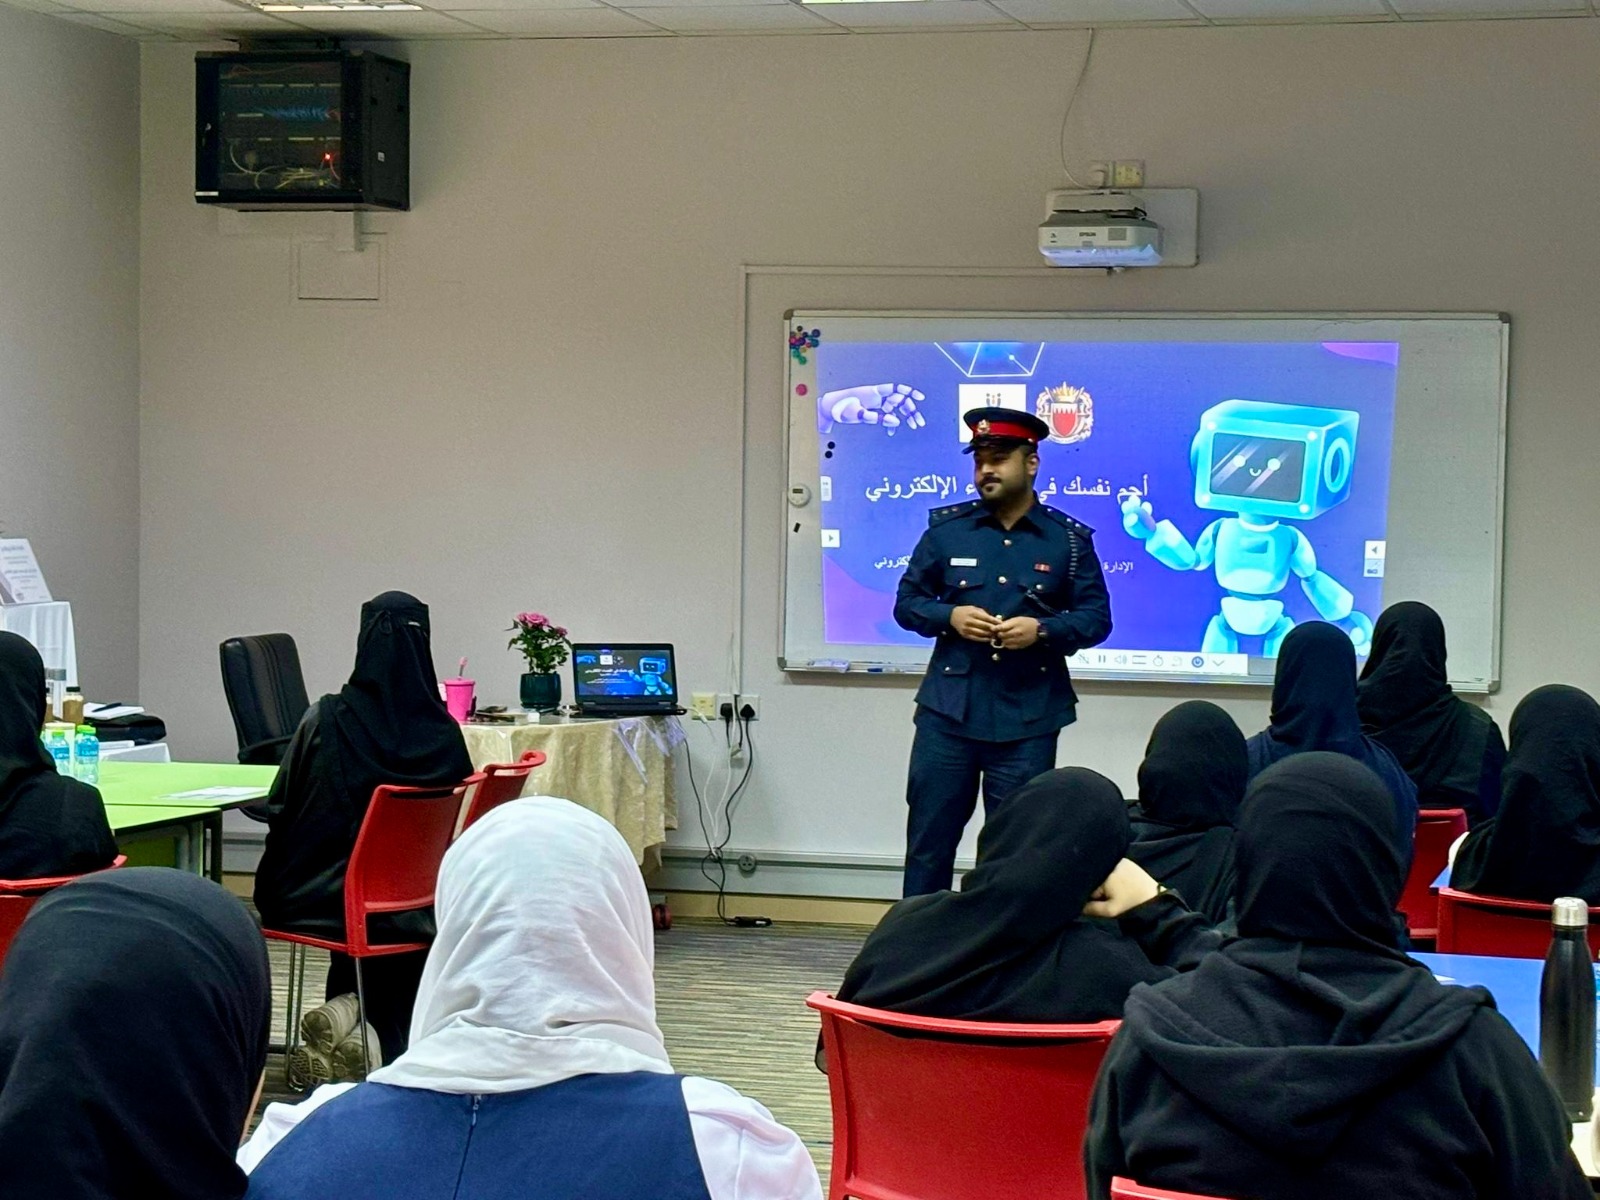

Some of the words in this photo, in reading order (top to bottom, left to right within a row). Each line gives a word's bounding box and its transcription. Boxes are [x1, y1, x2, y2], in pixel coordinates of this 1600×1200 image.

[865, 474, 957, 502] الإلكتروني
[1039, 477, 1057, 504] في
[1063, 476, 1111, 496] نفسك
